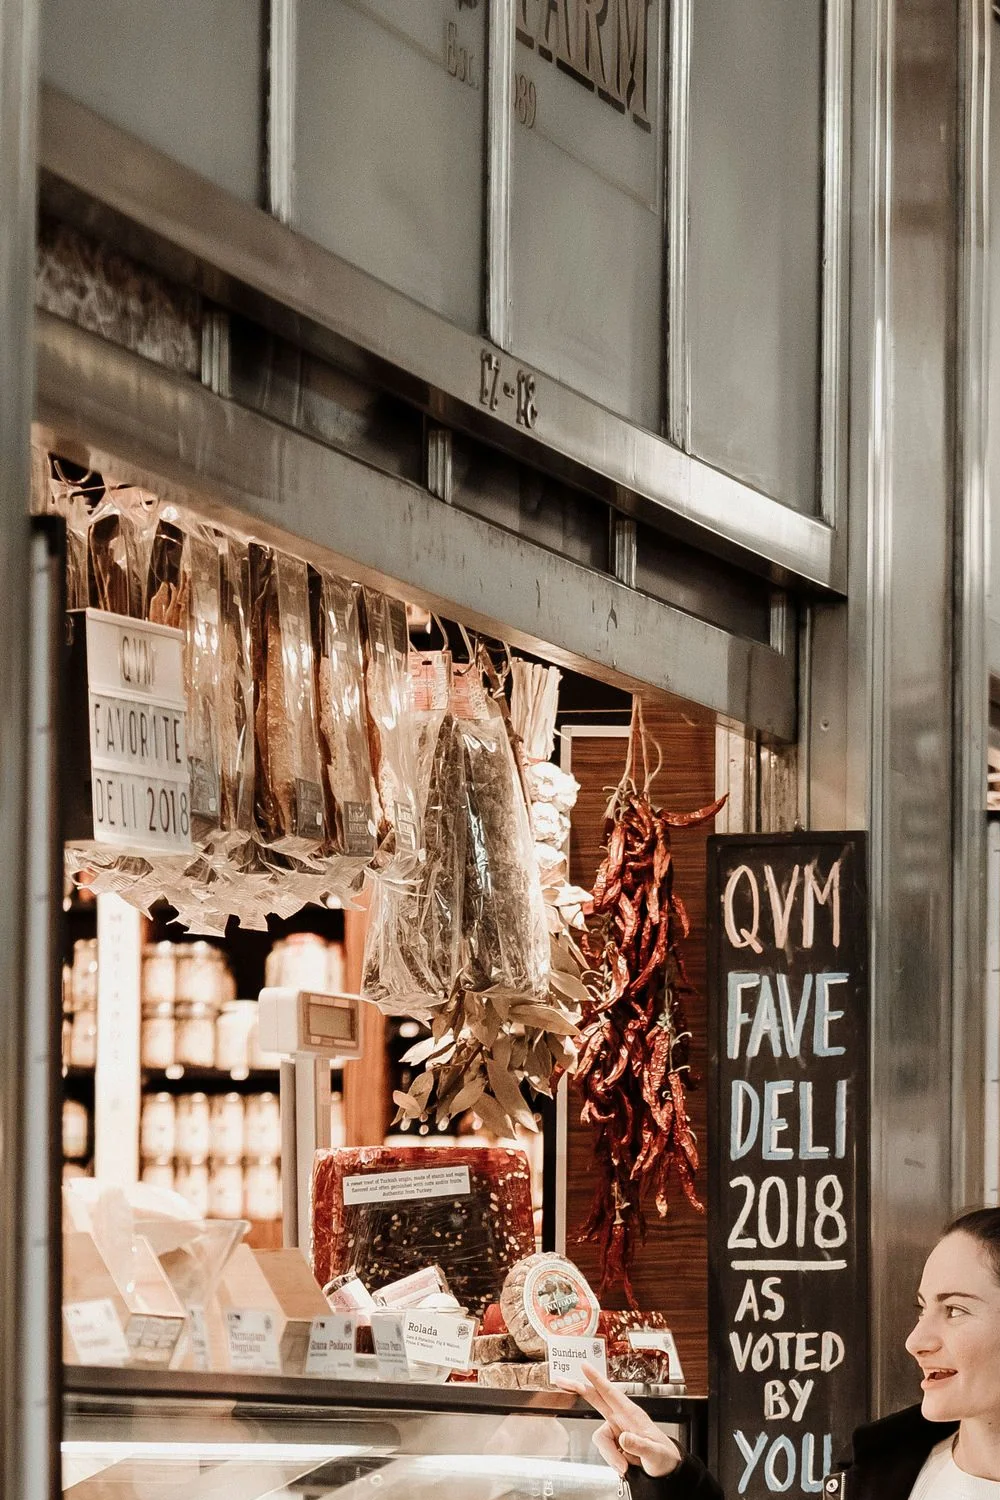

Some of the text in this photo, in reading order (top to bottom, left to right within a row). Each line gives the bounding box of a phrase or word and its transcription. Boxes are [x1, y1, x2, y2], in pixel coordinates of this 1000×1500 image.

[120, 634, 154, 685] QVM
[95, 703, 182, 764] FAVORITE
[96, 778, 190, 836] DELI 2018
[723, 861, 841, 954] QVM
[727, 971, 850, 1060] FAVE
[730, 1079, 847, 1161] DELI
[727, 1173, 848, 1249] 2018
[734, 1276, 785, 1322] AS
[407, 1321, 438, 1336] Rolada
[552, 1348, 588, 1359] Sundried
[729, 1331, 845, 1373] VOTED
[553, 1361, 570, 1372] Figs
[764, 1378, 814, 1422] BY
[733, 1429, 833, 1494] YOU
